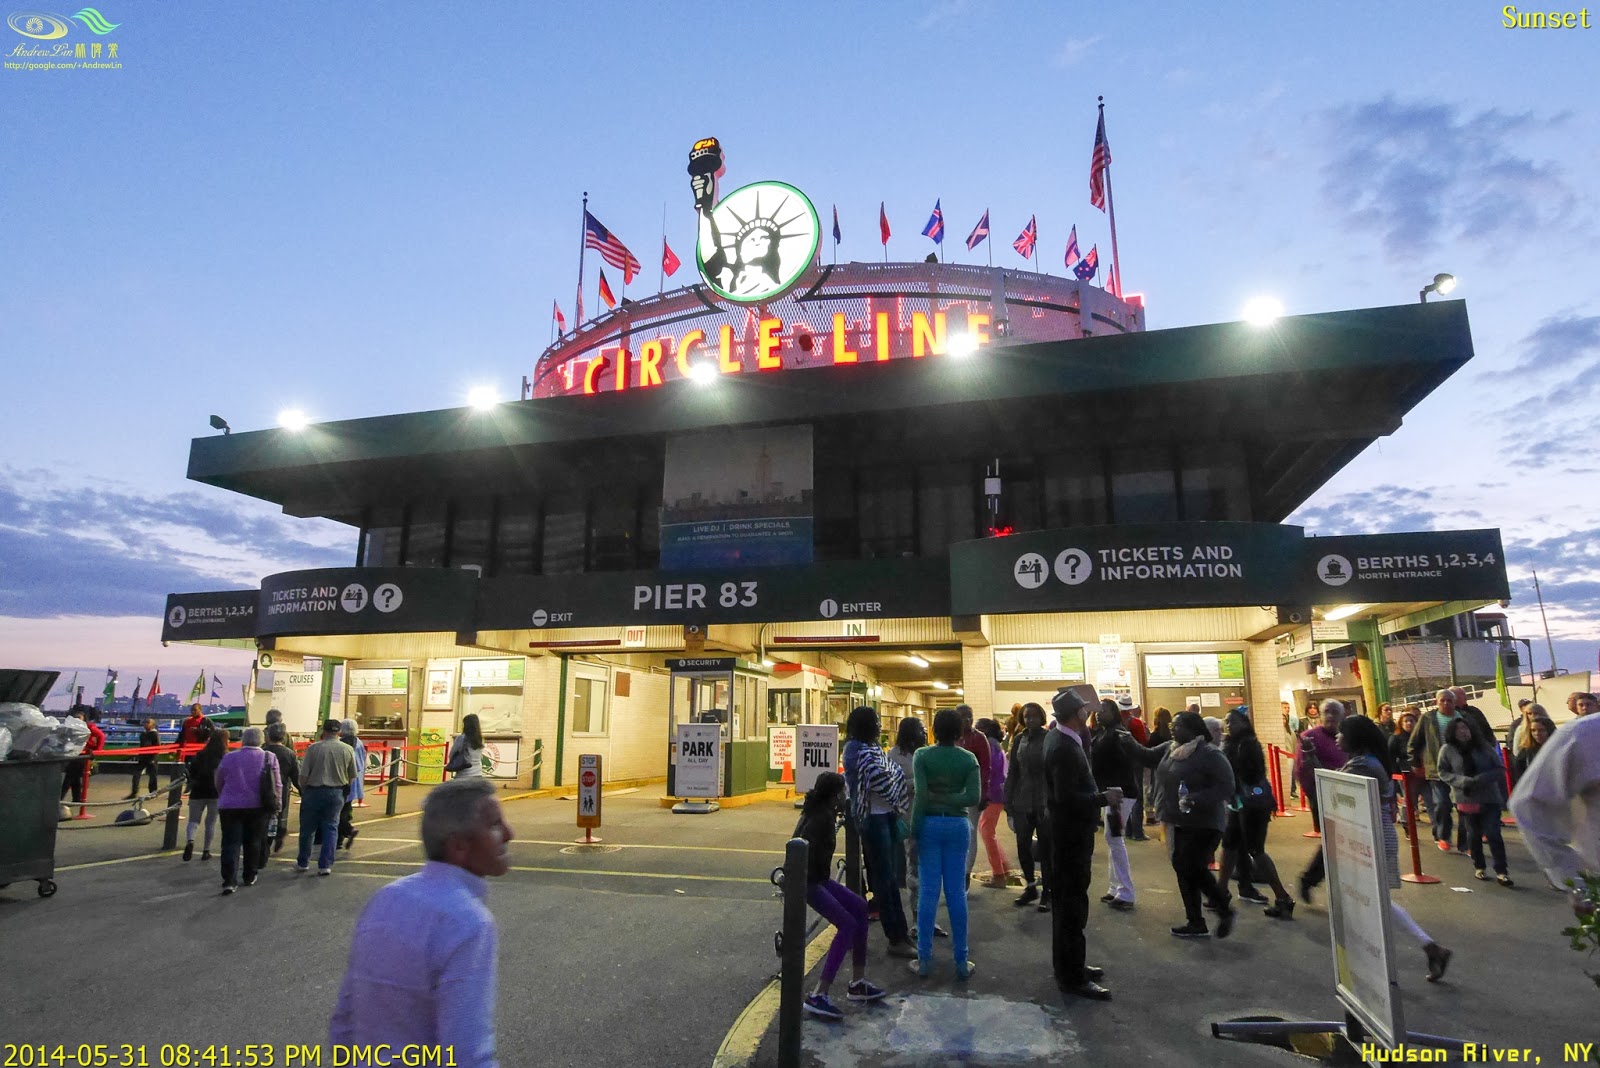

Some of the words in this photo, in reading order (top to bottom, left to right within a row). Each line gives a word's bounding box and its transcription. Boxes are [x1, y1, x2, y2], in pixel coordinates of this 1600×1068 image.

[583, 317, 783, 396] CIRCLE
[832, 310, 991, 365] LINE
[693, 525, 710, 533] LIVE
[729, 523, 752, 531] DRINK
[754, 521, 791, 529] SPECIALS
[1098, 546, 1183, 564] TICKETS
[1192, 545, 1233, 560] AND
[1357, 554, 1430, 570] BERTHS
[1435, 552, 1496, 569] 1,2,3,4
[1101, 563, 1242, 581] INFORMATION
[1358, 572, 1390, 580] NORTH
[1392, 570, 1443, 579] ENTRANCE
[272, 587, 308, 602] TICKETS
[311, 586, 338, 599] AND
[633, 584, 706, 611] PIER
[719, 581, 758, 608] 83
[188, 607, 223, 617] BERTHS
[225, 605, 254, 617] 1,2,3,4
[268, 599, 337, 616] INFORMATION
[842, 602, 882, 613] ENTER
[550, 612, 573, 622] EXIT
[627, 629, 644, 642] OUT
[846, 623, 862, 636] IN
[289, 674, 314, 684] CRUISES
[682, 741, 714, 757] PARK
[582, 756, 596, 765] STOP
[803, 748, 830, 768] FULL
